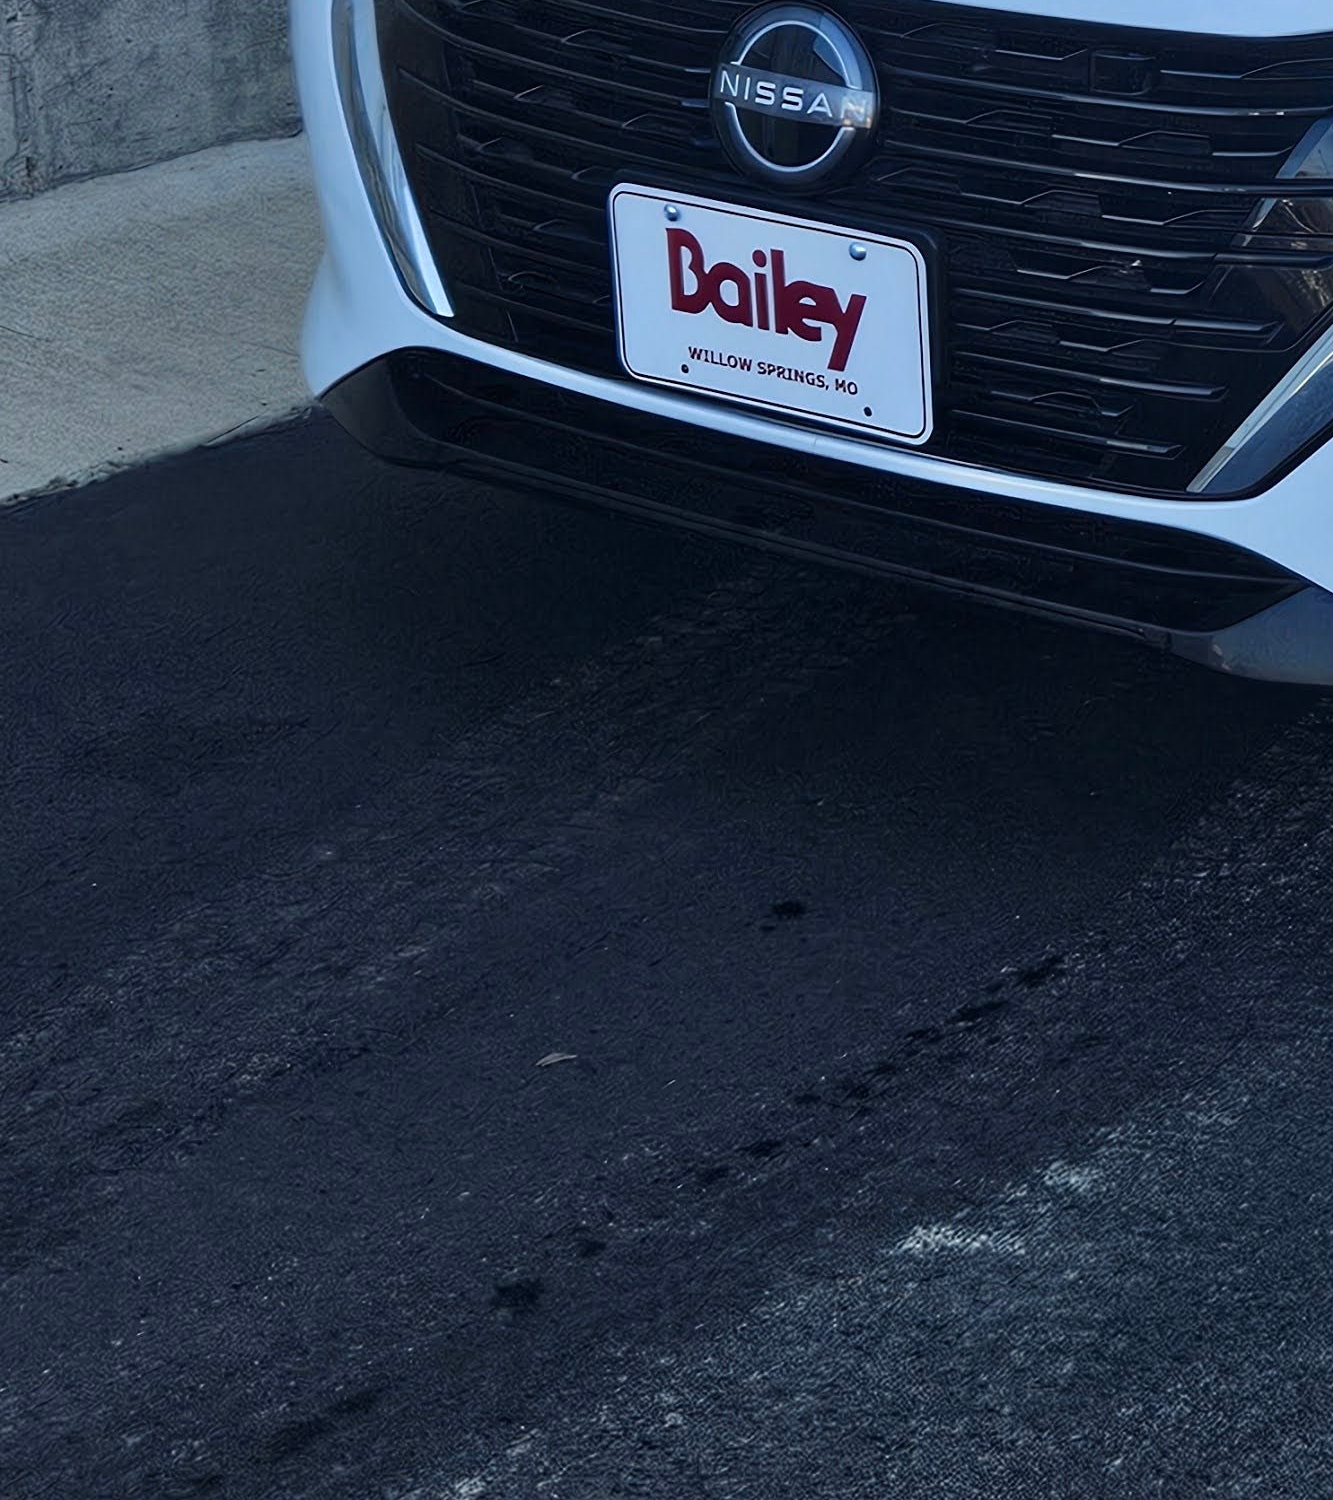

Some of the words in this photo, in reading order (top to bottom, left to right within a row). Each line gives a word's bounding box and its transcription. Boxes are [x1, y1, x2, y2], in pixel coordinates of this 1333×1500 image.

[719, 69, 869, 125] NISSAN
[665, 227, 867, 372] Bailey
[688, 346, 753, 372] WILLOW
[756, 361, 829, 391] SPRINGS,
[834, 378, 859, 396] MO
